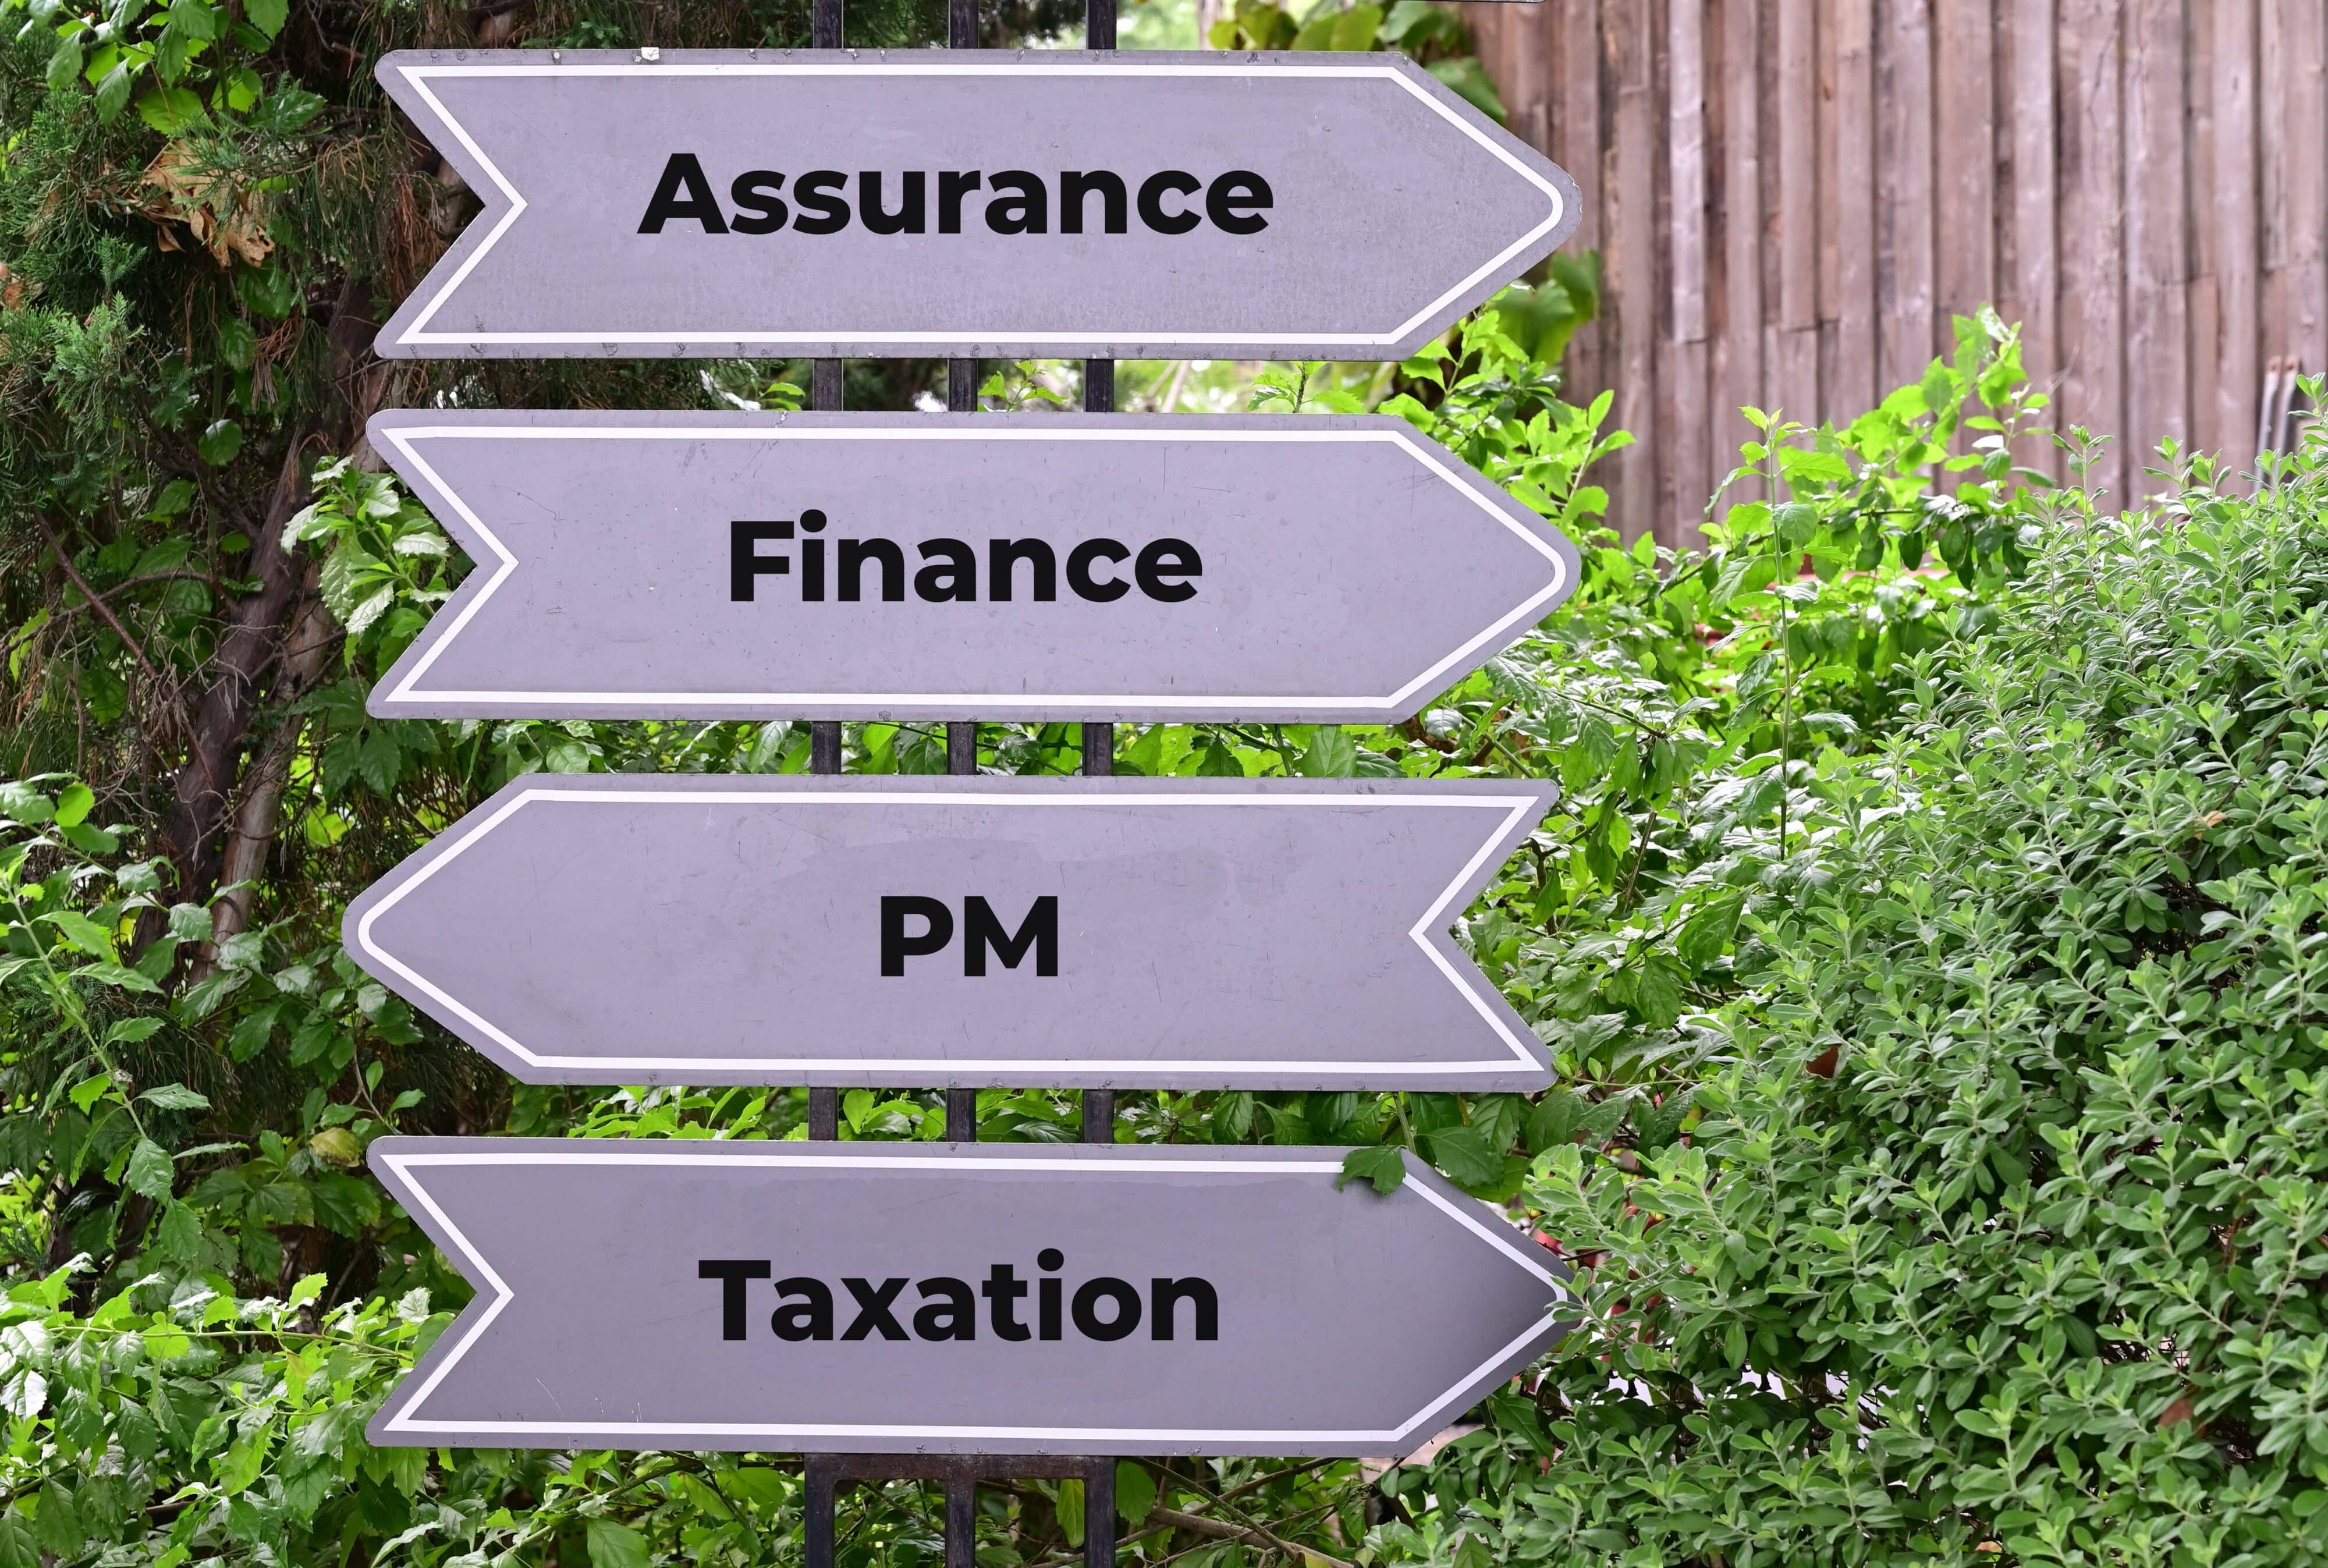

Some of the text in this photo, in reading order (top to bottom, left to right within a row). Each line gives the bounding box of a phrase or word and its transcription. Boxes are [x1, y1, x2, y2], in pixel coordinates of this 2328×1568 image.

[637, 153, 1274, 235] Assurance
[730, 509, 1202, 602] Finance
[881, 896, 1058, 977] PM
[698, 1248, 1219, 1342] Taxation
